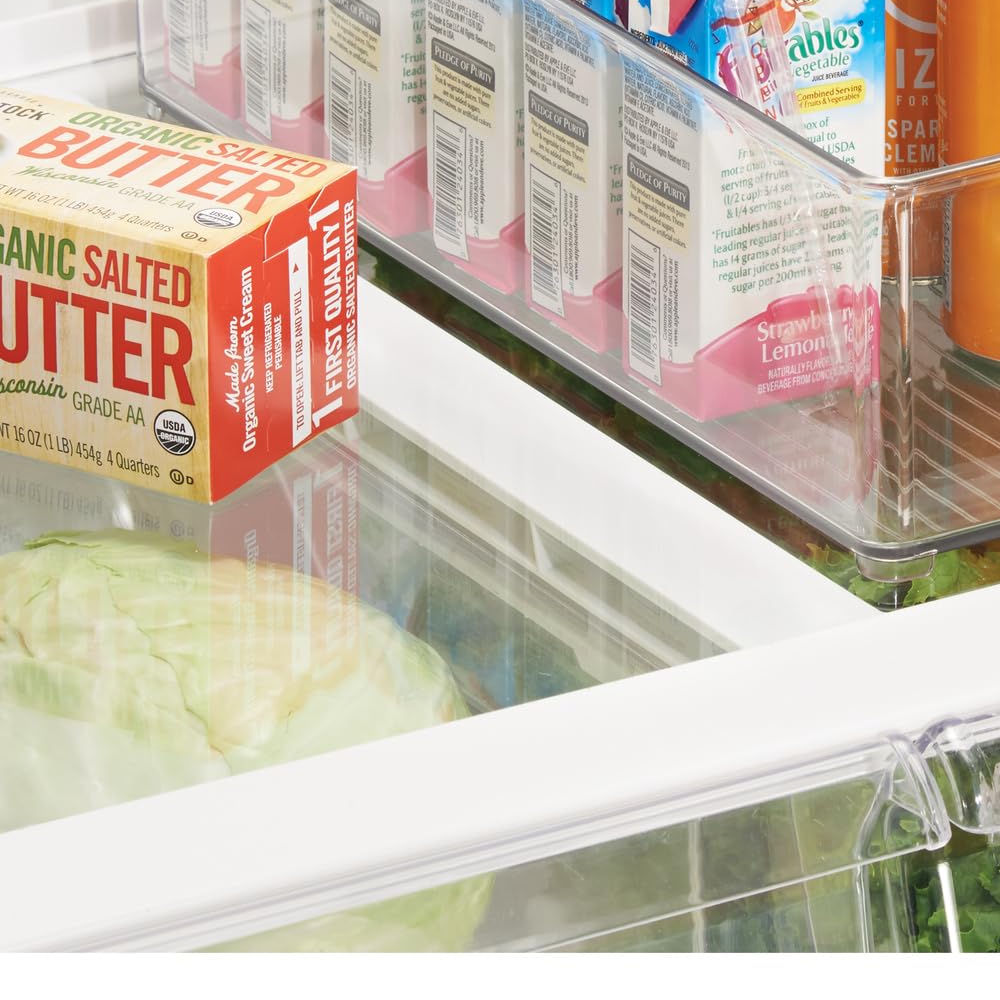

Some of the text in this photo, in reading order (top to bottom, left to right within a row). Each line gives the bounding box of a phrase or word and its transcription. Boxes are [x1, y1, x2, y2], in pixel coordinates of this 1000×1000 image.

[434, 44, 492, 85] PLEDGE PURITY
[825, 69, 849, 82] BEVERAGE
[836, 83, 862, 96] Serving
[562, 117, 586, 139] PURITY
[819, 117, 829, 128] of
[826, 133, 837, 142] to
[68, 111, 328, 178] ORGANIC SALTED
[16, 126, 295, 215] BUTTER
[630, 162, 687, 204] PLEDGE PURITY
[721, 171, 754, 194] serving
[14, 165, 195, 211] Wisconsin GRADE AA
[127, 215, 175, 234] Quarters
[762, 215, 778, 230] has
[714, 231, 782, 254] leading regular
[712, 249, 770, 269] has grams
[718, 260, 780, 283] regular juices
[83, 245, 192, 308] SALTED
[731, 278, 774, 294] sugar per
[344, 199, 358, 391] ORGANIC SALTED BUTTER
[293, 287, 303, 339] AND PULL
[309, 200, 343, 428] 1 FIRST QUALITY 1
[263, 302, 274, 393] KEEP REFRIGERATED
[273, 313, 283, 370] PERISHABLE
[224, 315, 243, 413] Made from
[239, 265, 259, 453] Organic Sweet Cream
[757, 380, 792, 394] BEVERAGE
[72, 391, 147, 428] GRADE AA
[158, 431, 191, 445] ORGANIC
[162, 418, 187, 434] USDA
[14, 424, 161, 479] 16 OZ LB) 454g Quarters
